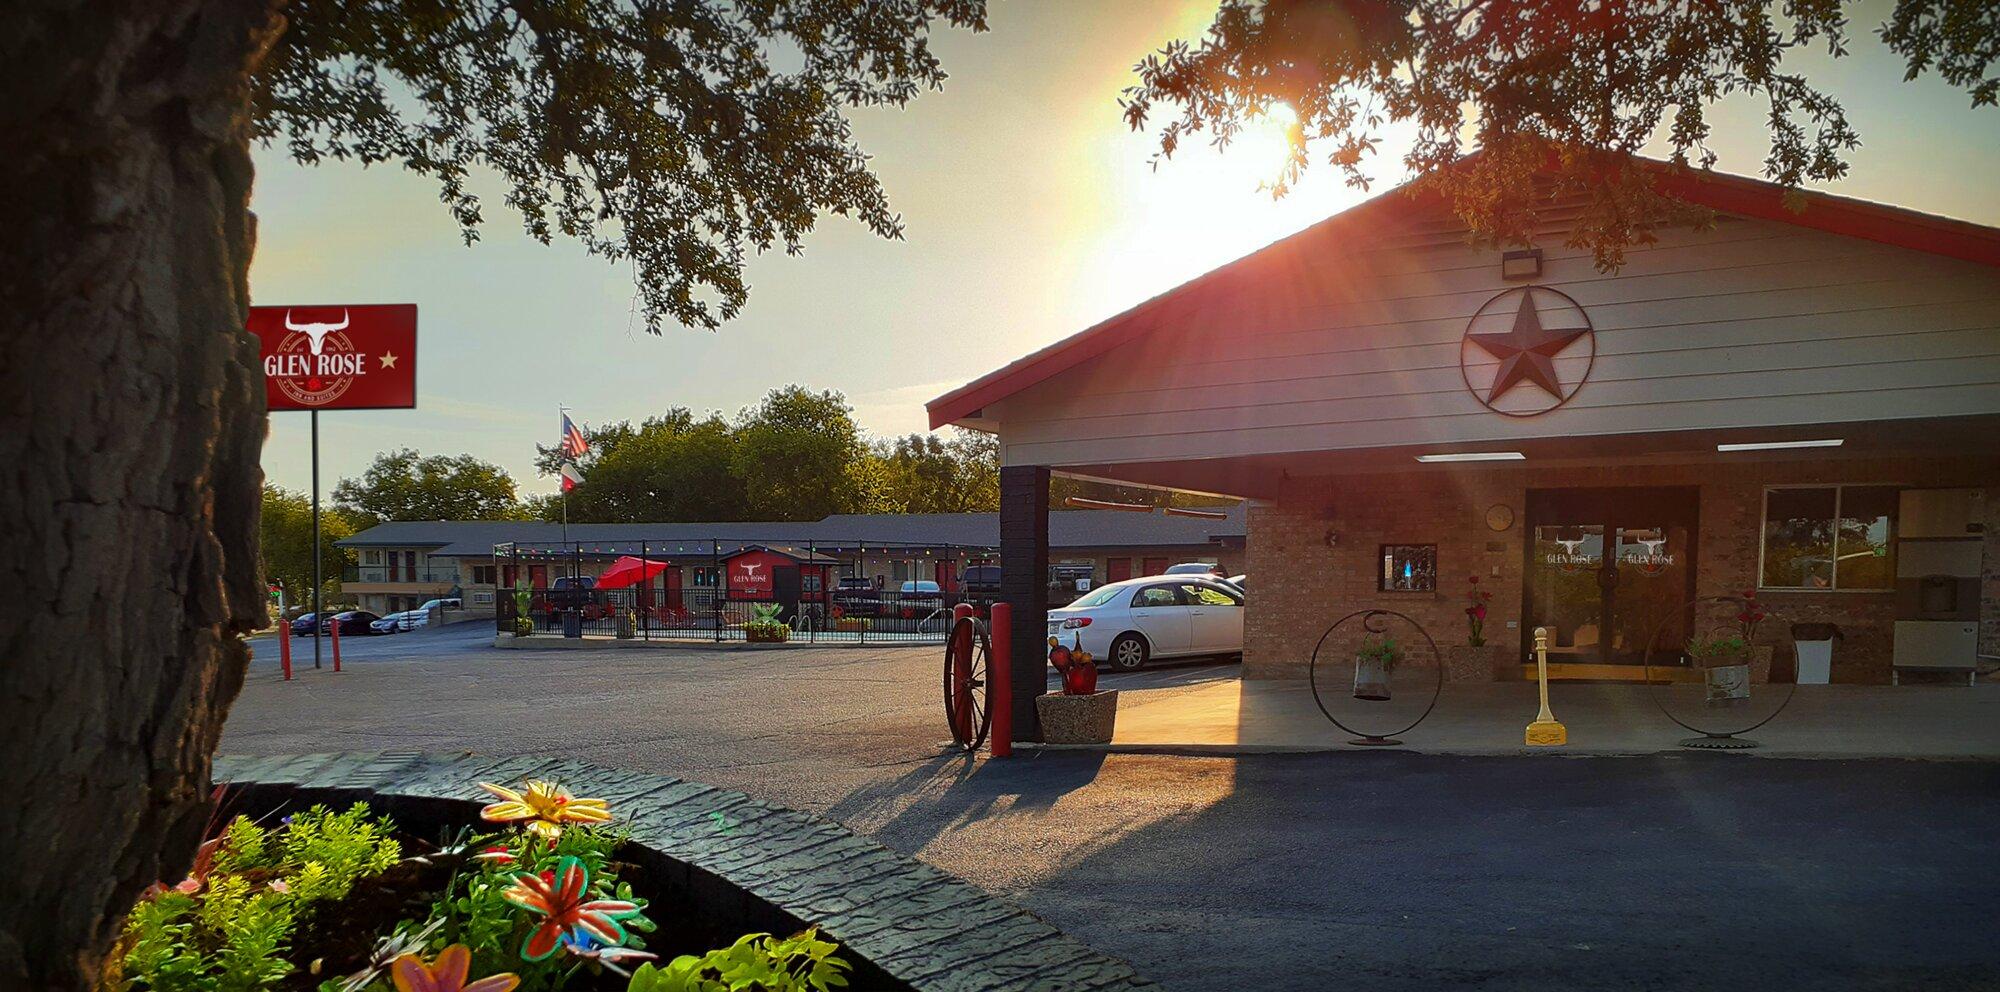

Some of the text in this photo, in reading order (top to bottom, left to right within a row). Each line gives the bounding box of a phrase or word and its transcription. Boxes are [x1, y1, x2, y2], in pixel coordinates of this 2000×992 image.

[264, 353, 366, 376] GLEN ROSE
[1547, 554, 1593, 564] GLEN ROSE
[1628, 554, 1674, 565] GLEN ROSE
